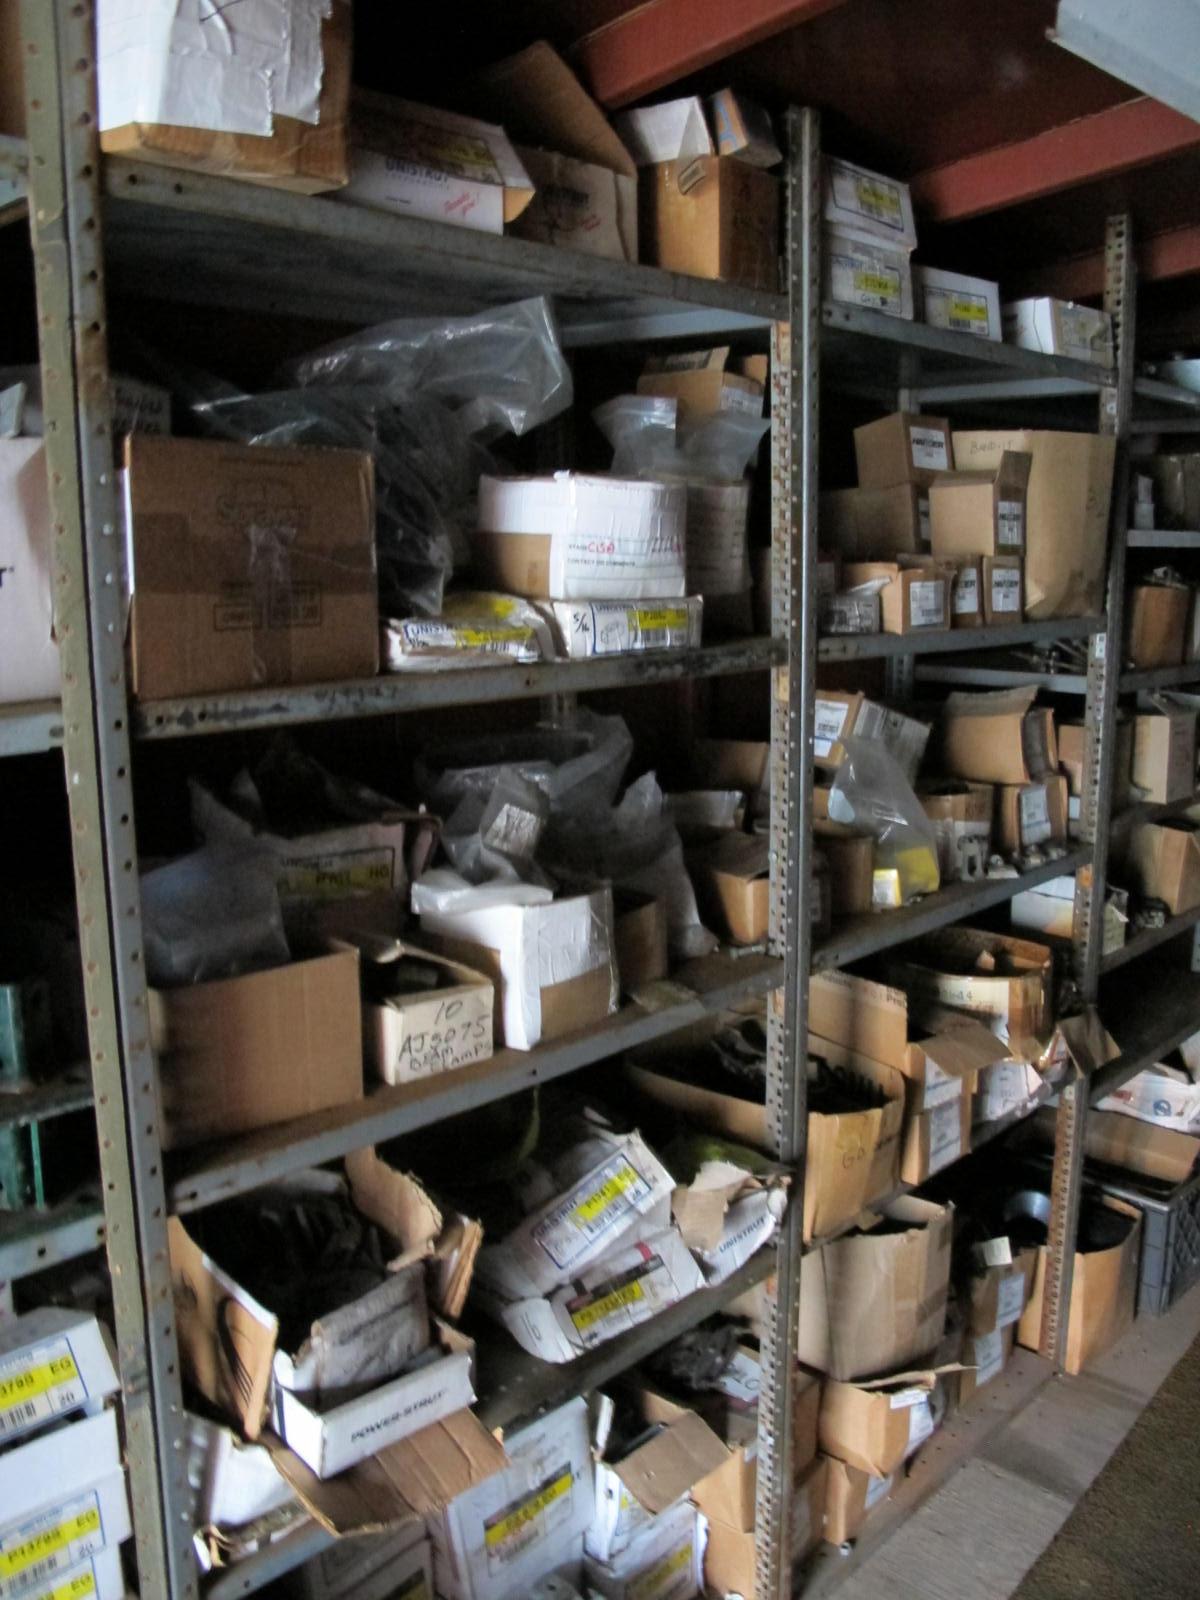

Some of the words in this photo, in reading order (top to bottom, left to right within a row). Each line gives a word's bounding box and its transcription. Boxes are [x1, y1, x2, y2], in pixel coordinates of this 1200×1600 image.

[385, 159, 450, 183] UNISTRUT
[434, 999, 464, 1026] 10
[719, 1215, 767, 1254] UNISTRUT
[350, 1386, 448, 1444] POWER-STRUT
